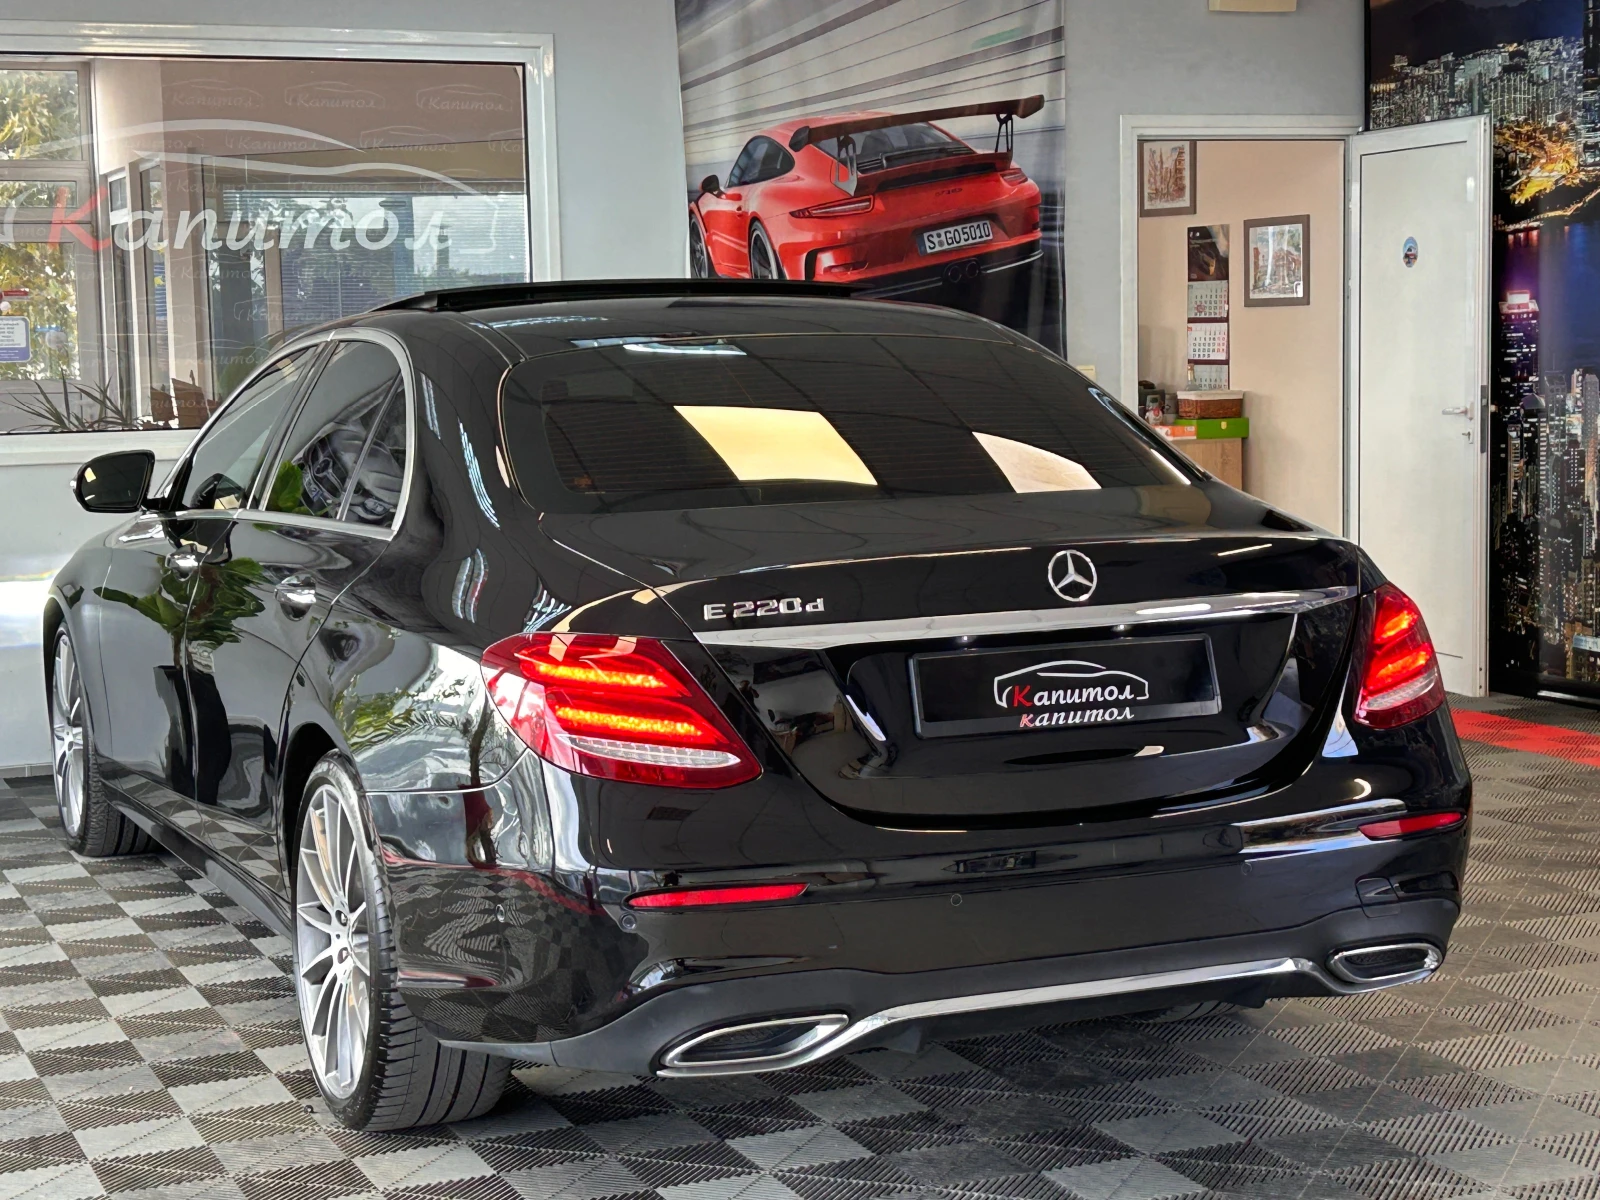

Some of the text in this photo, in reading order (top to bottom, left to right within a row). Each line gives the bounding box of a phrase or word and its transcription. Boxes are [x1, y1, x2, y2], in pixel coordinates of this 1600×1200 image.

[298, 93, 378, 109] Капитол
[427, 96, 505, 111] Капитол
[47, 186, 453, 253] Капитол
[926, 233, 937, 250] S
[703, 602, 727, 621] E
[1011, 684, 1135, 708] Капитол
